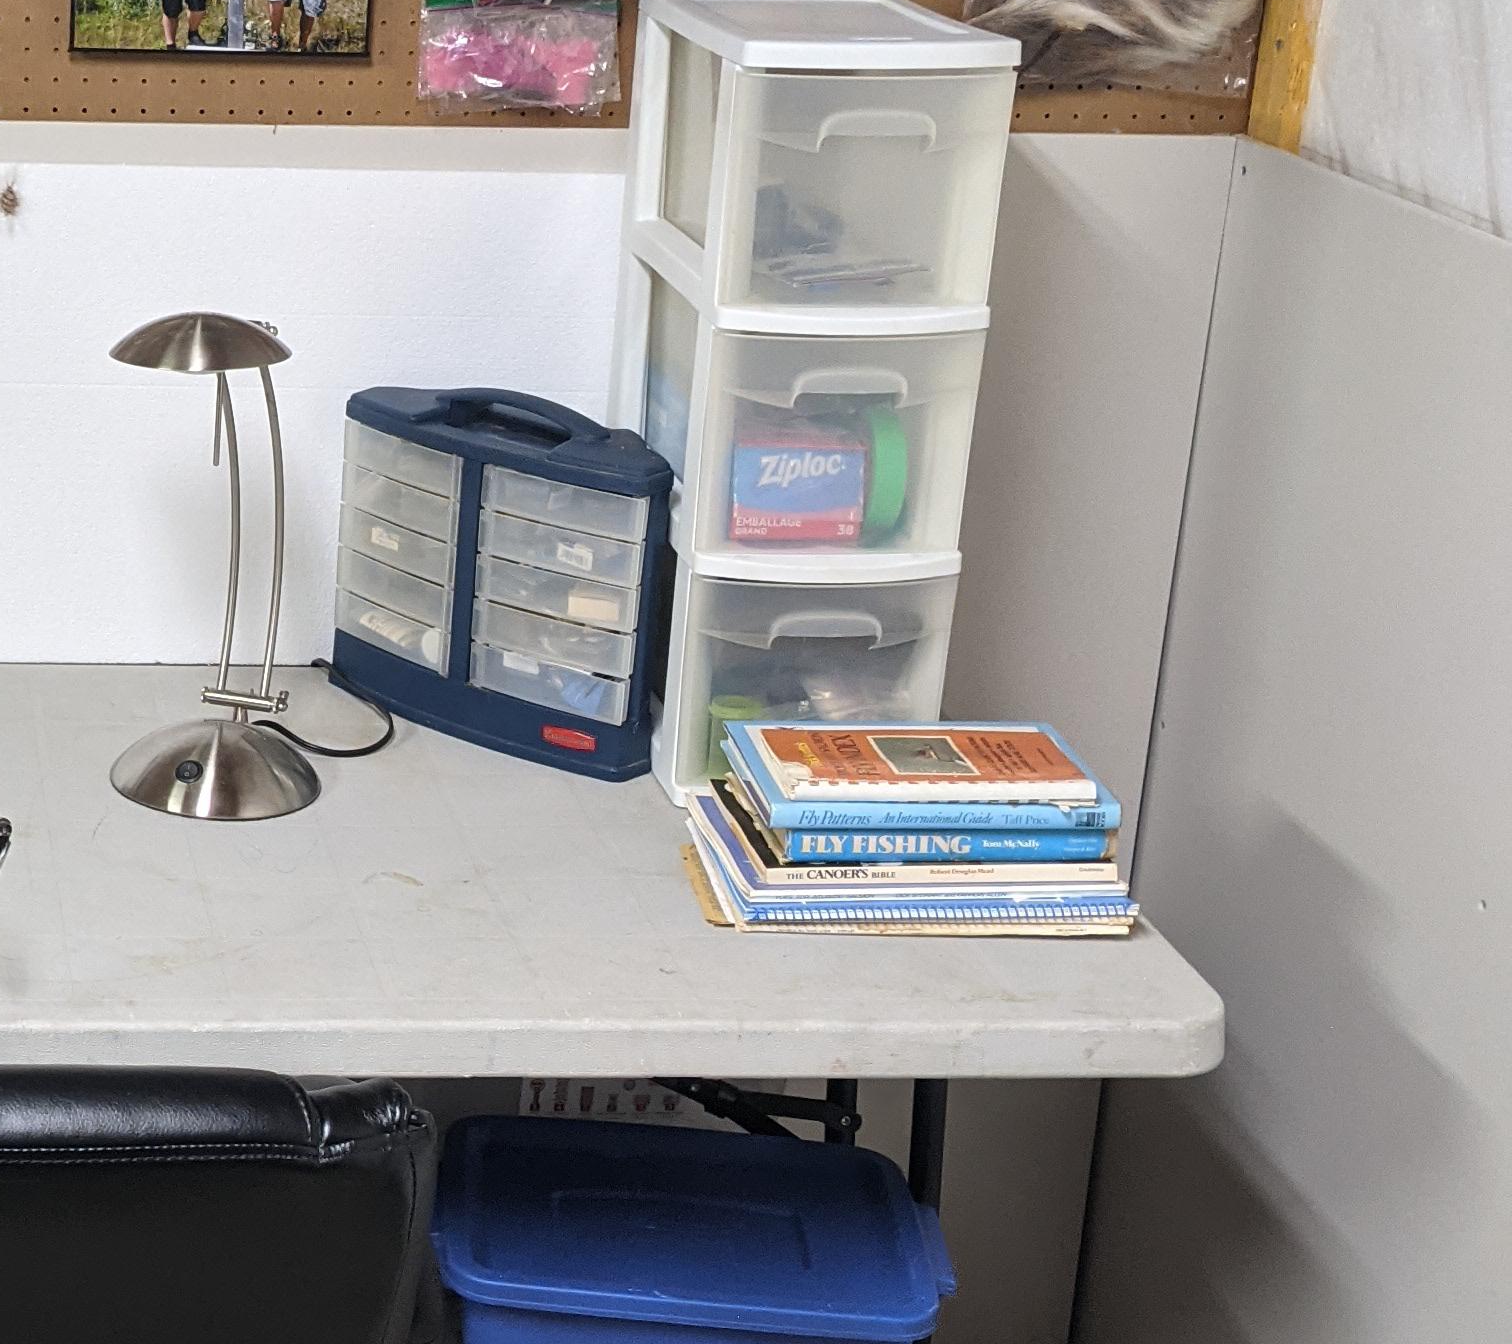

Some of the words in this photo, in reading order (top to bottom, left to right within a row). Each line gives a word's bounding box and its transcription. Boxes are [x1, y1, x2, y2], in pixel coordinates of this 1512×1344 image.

[757, 452, 842, 488] Ziploc
[798, 810, 820, 826] Fly
[879, 812, 895, 824] An
[896, 812, 961, 824] International
[962, 811, 994, 824] Guide
[1024, 814, 1050, 825] Price
[800, 835, 848, 854] FLY
[852, 835, 971, 854] FISHING
[806, 869, 869, 880] CANOER'S
